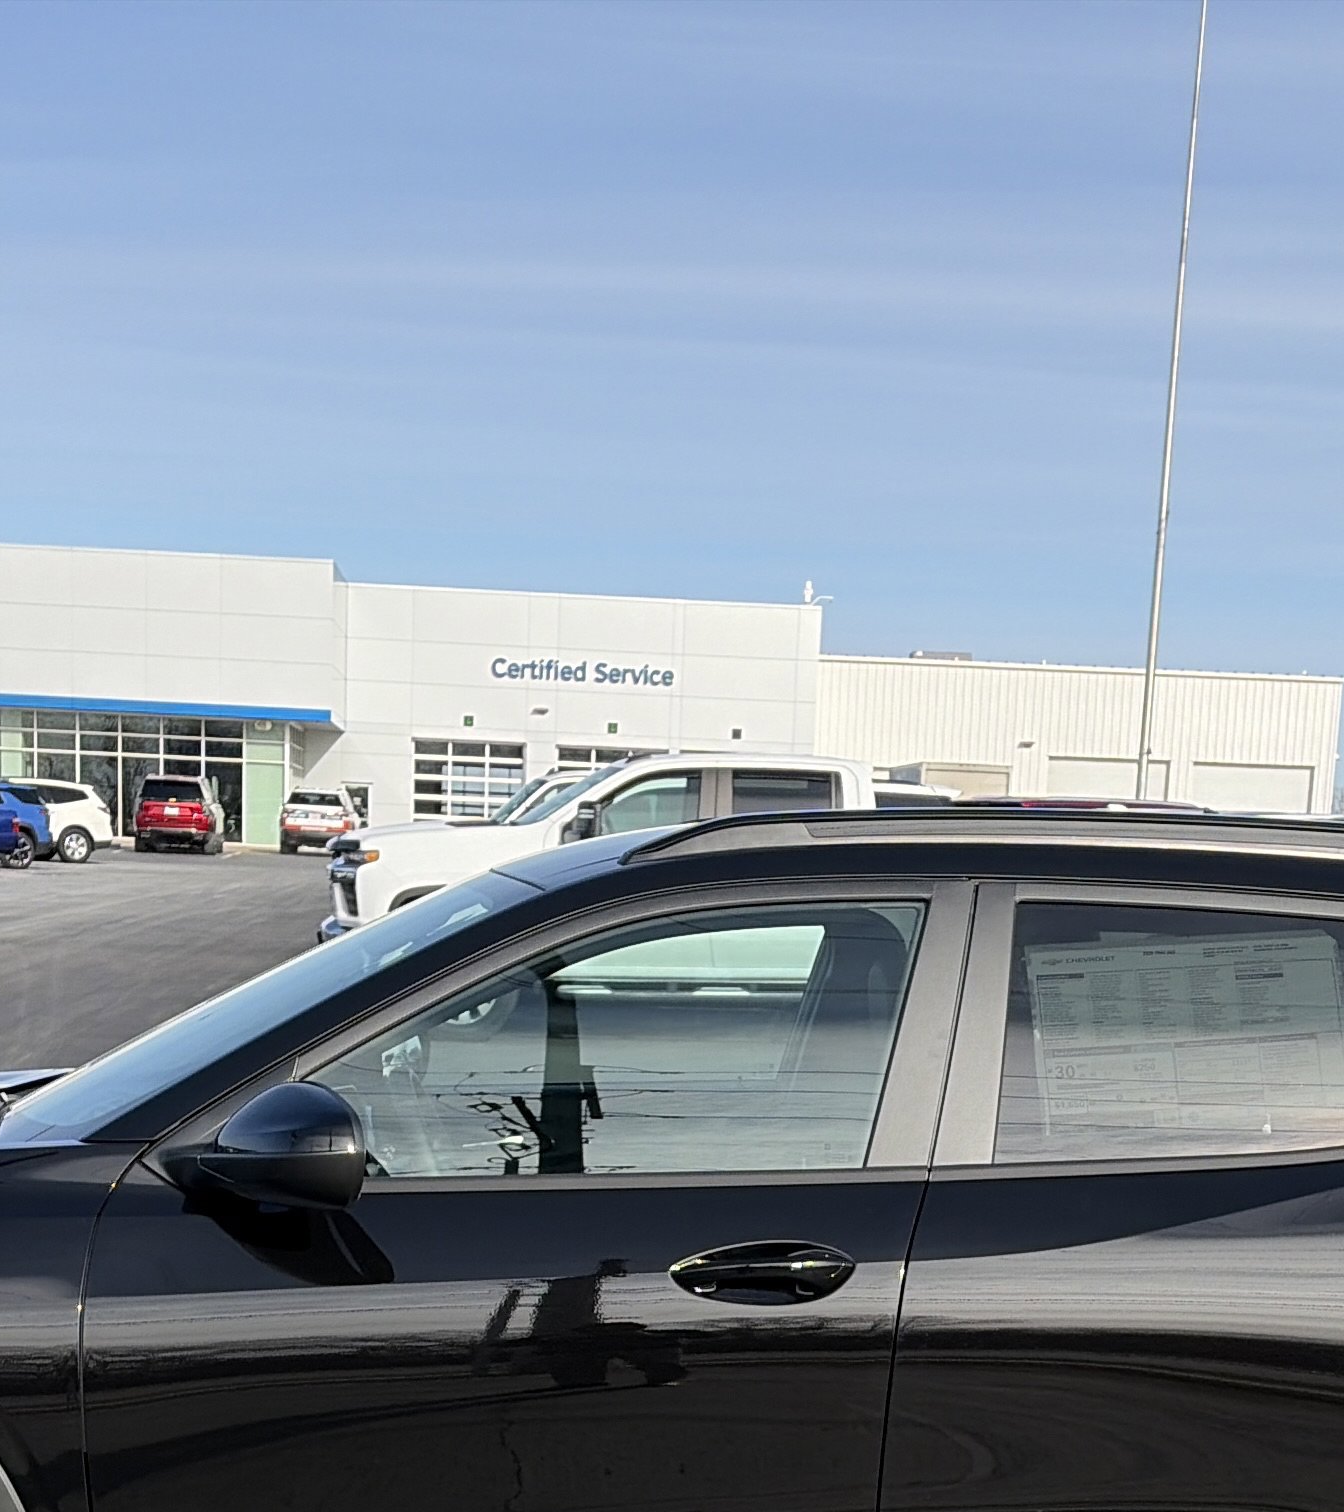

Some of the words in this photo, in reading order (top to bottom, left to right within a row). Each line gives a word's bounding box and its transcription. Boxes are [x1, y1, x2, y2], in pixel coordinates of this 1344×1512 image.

[490, 656, 588, 683] Certified
[593, 661, 676, 688] Service
[1064, 954, 1116, 965] CHEVROLET
